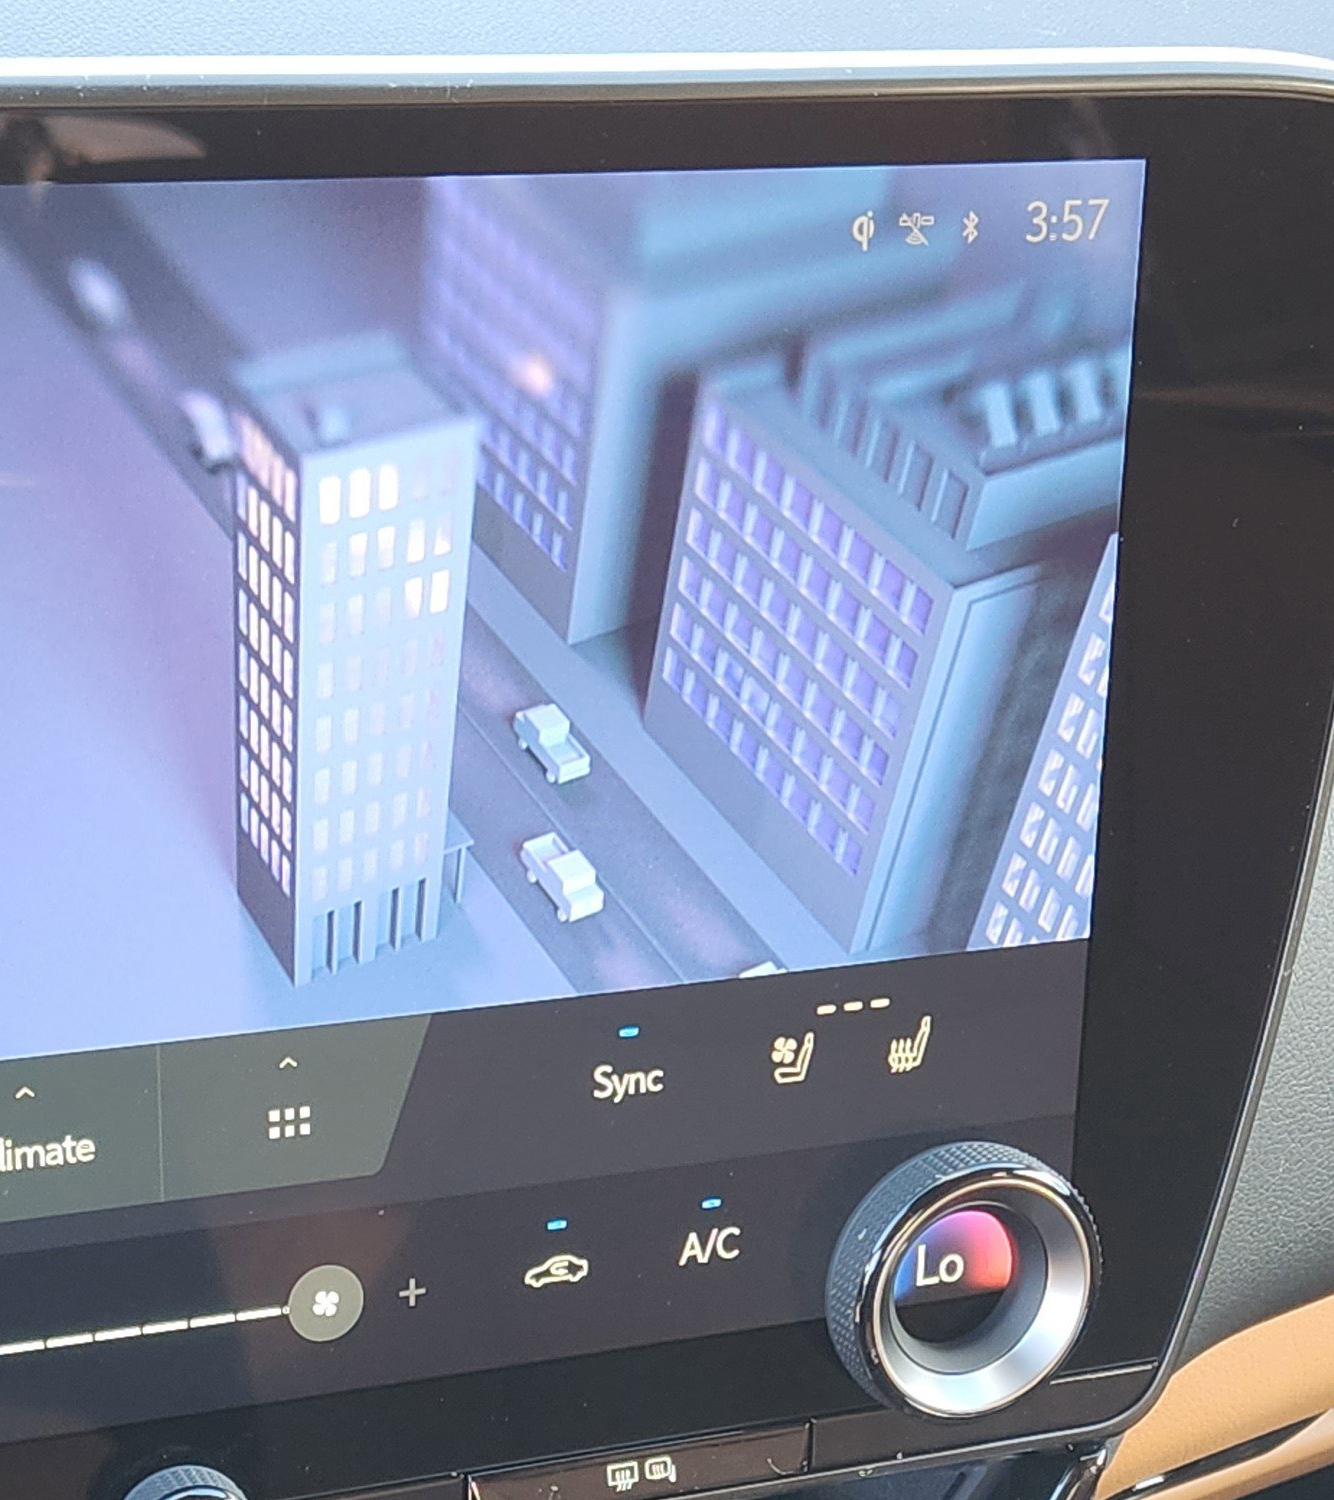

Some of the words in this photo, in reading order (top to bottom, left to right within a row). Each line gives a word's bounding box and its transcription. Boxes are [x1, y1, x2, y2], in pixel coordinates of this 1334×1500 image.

[1025, 198, 1111, 243] 3:57
[592, 1064, 665, 1103] Sync
[677, 1227, 742, 1267] A/C
[914, 1243, 965, 1287] Lo
